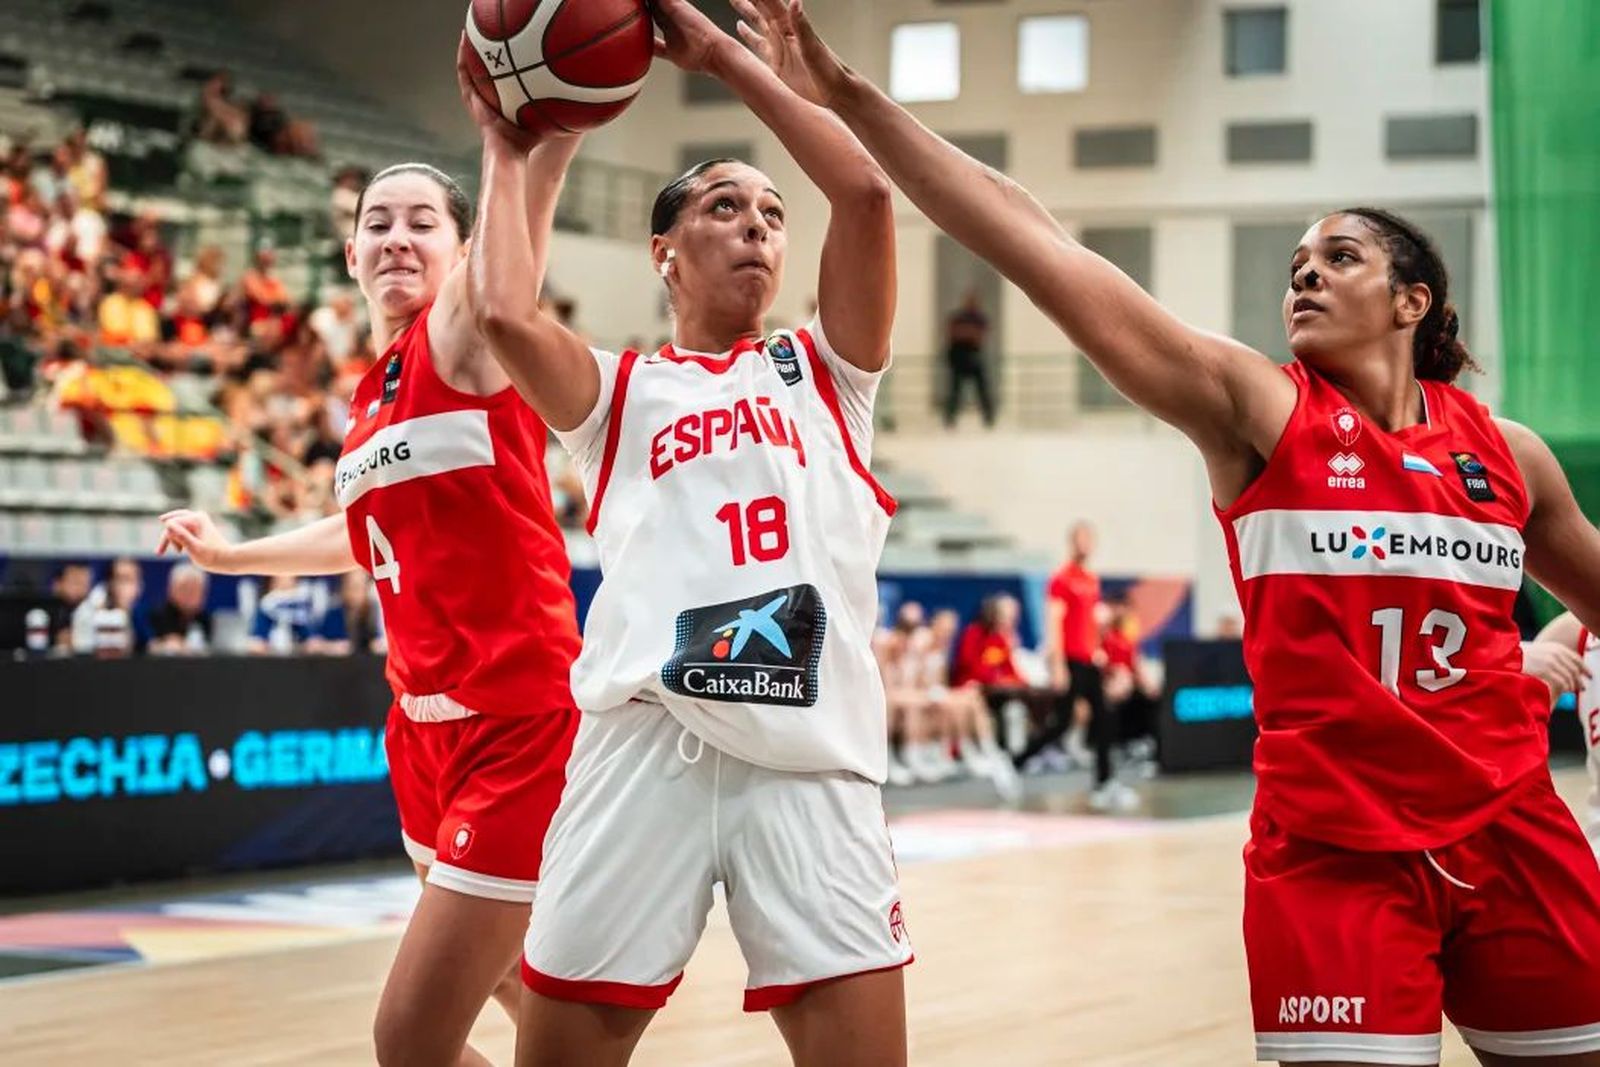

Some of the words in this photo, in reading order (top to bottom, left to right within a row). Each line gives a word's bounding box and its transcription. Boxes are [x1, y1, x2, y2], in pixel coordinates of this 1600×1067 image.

[1327, 475, 1366, 489] errea
[715, 495, 790, 567] 18
[1310, 525, 1521, 570] LUXEMBOURG
[365, 513, 401, 595] 4
[1371, 607, 1468, 700] 13
[682, 667, 805, 700] CaixaBank
[1278, 994, 1366, 1025] ASPORT
